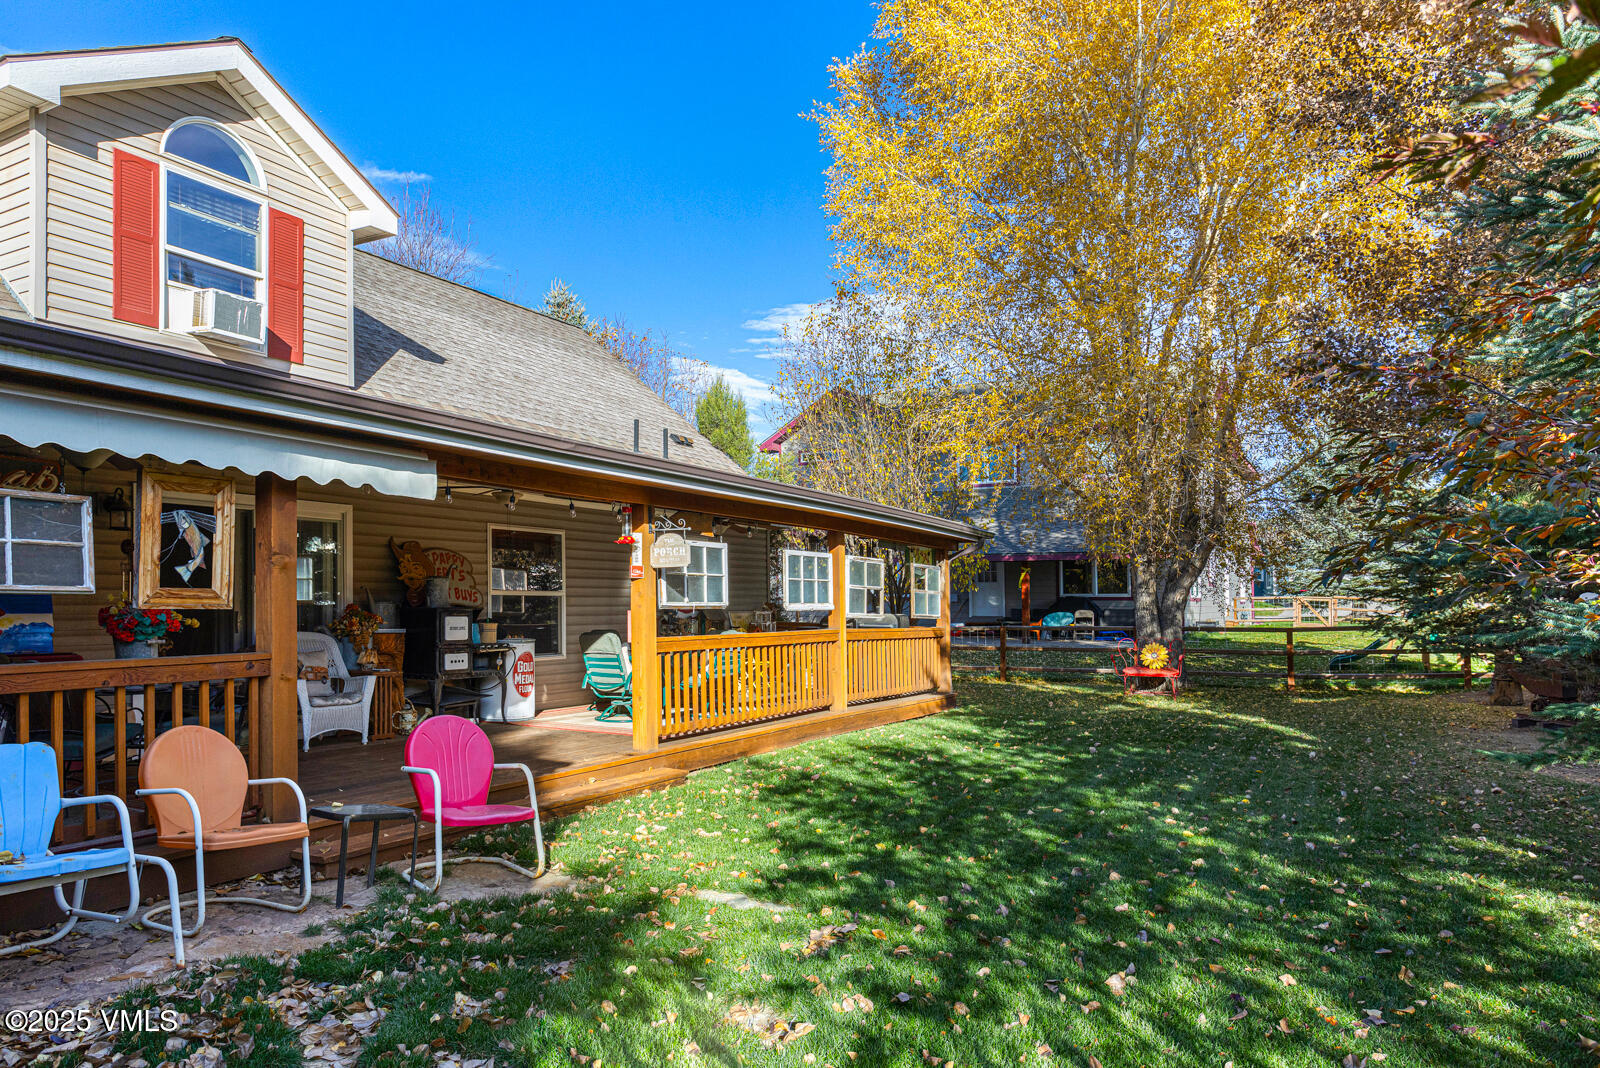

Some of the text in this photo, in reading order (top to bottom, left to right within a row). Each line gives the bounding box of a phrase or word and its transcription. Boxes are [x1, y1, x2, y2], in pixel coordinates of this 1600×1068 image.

[654, 547, 685, 556] PORCH
[432, 552, 464, 568] PAPPY
[454, 587, 478, 602] BUYS
[517, 660, 534, 672] GOLD
[514, 672, 535, 685] MEDAL
[518, 684, 533, 693] FLOUR
